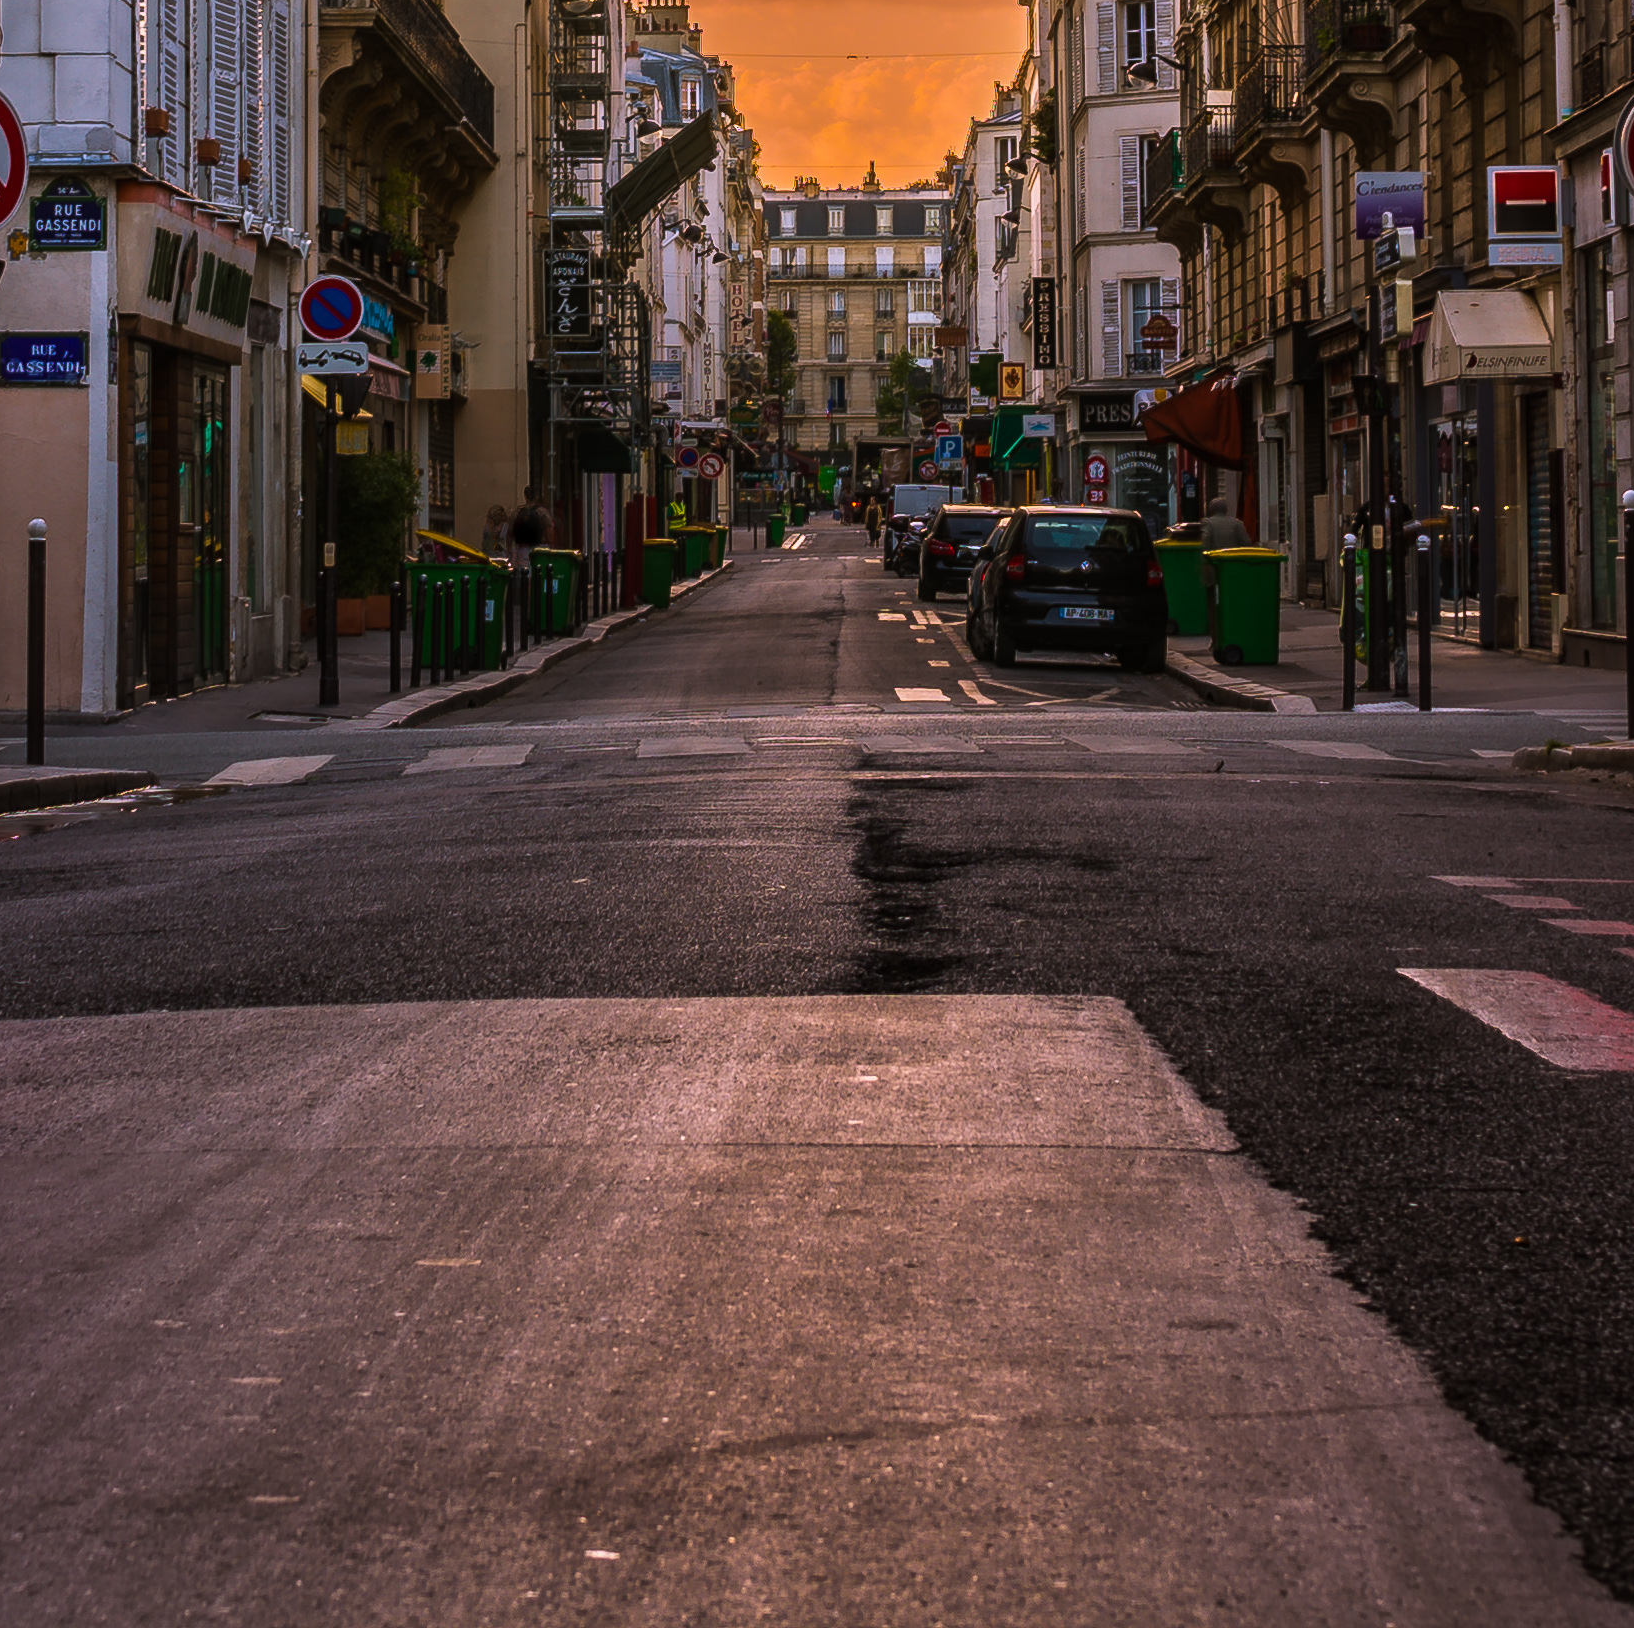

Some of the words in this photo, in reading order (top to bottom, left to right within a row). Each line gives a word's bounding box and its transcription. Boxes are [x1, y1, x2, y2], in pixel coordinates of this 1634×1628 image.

[54, 204, 83, 217] RUE
[35, 219, 102, 232] GASSENDI
[546, 252, 589, 266] RSTAURANT
[552, 267, 585, 276] APONAIS
[732, 284, 744, 344] HOTEL
[31, 345, 57, 357] RUE
[6, 361, 81, 374] GASSENDI
[442, 326, 450, 398] IMMOBILIER
